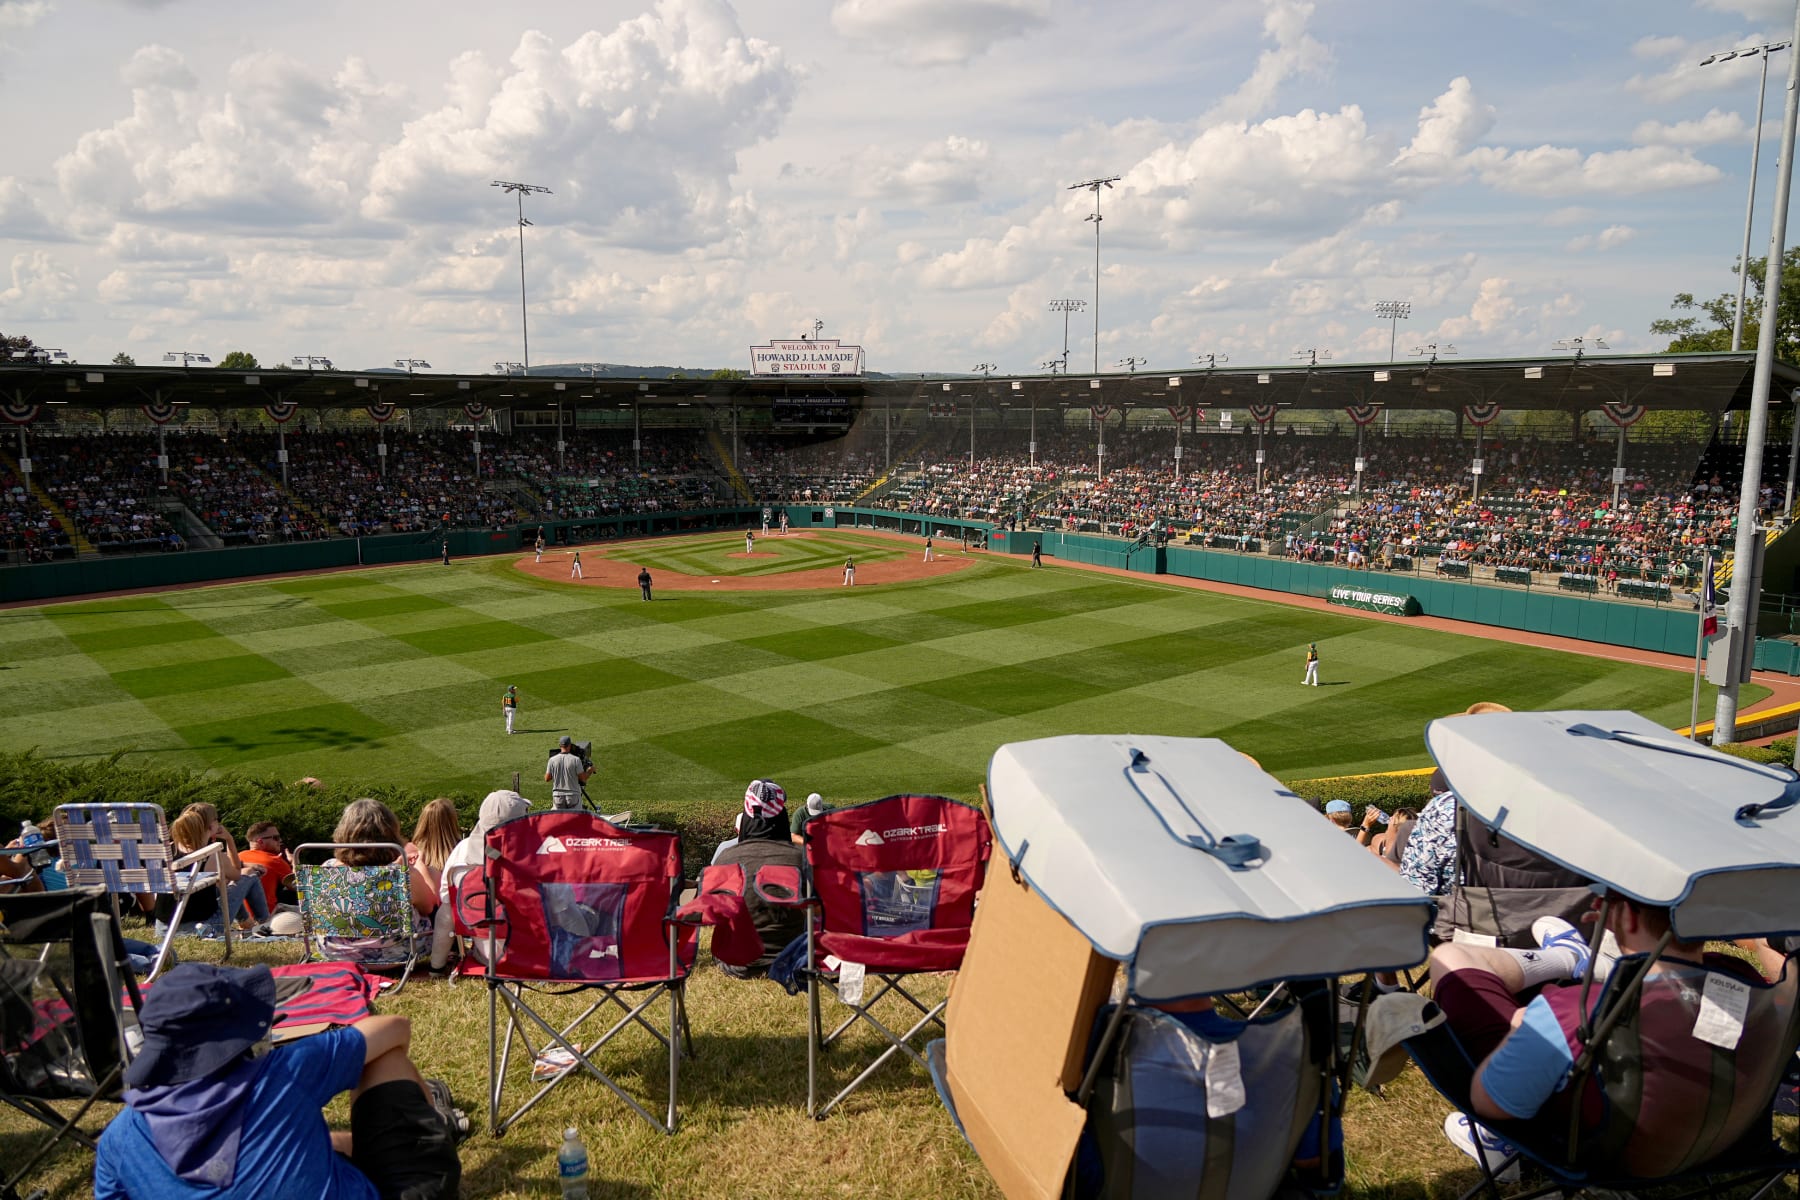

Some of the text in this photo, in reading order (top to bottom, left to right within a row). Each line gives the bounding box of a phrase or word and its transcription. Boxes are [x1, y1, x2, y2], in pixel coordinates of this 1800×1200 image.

[757, 354, 800, 362] HOWARD
[811, 354, 854, 362] LAMADE
[1332, 588, 1400, 606] LIVE YOUR SERIES
